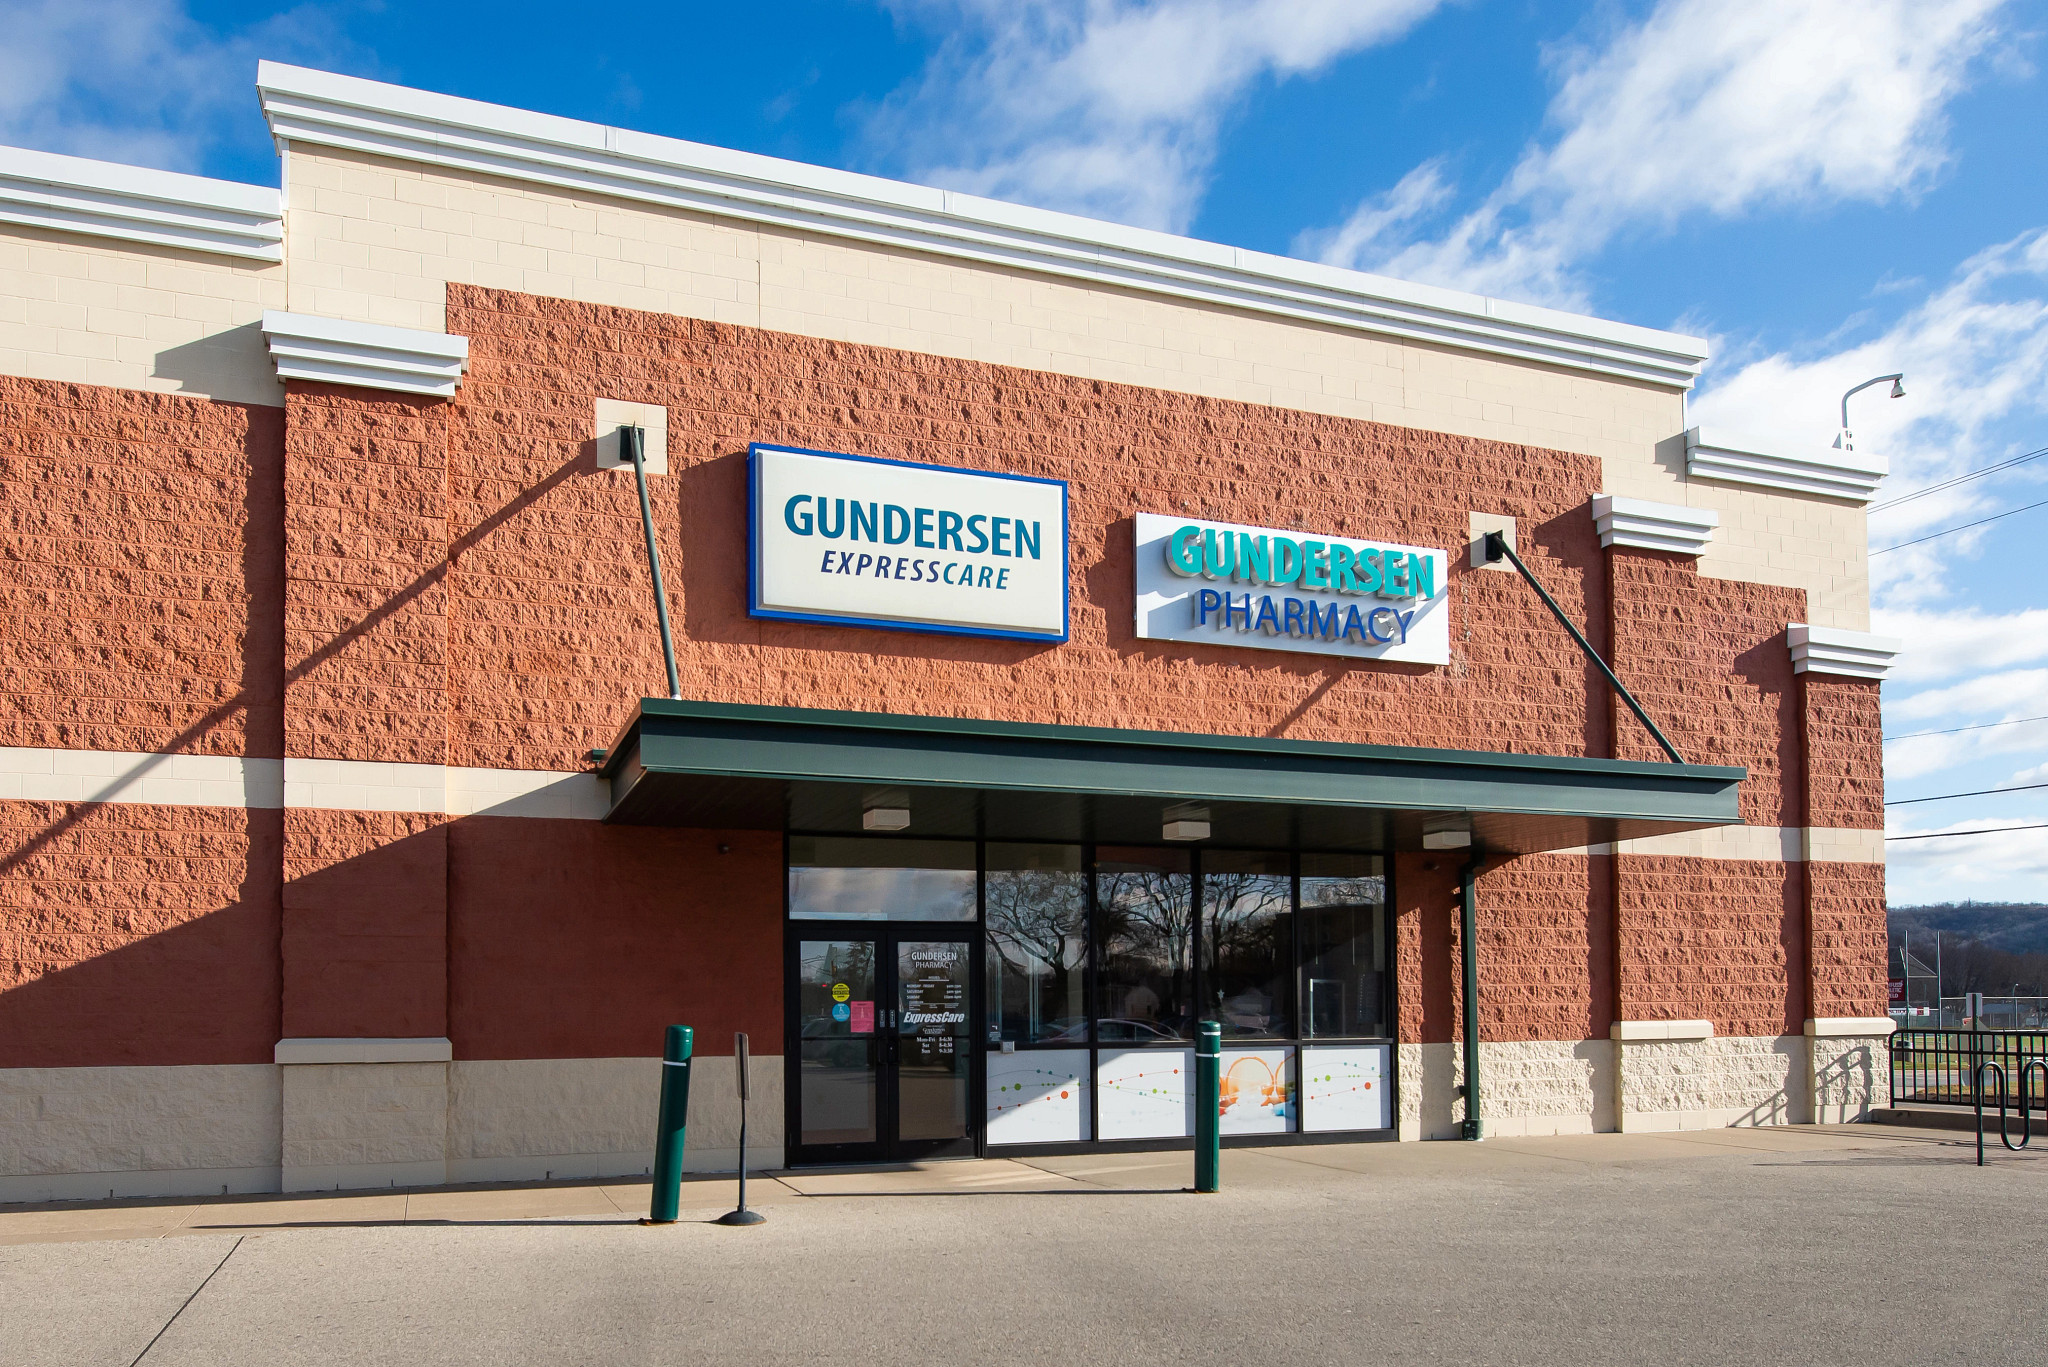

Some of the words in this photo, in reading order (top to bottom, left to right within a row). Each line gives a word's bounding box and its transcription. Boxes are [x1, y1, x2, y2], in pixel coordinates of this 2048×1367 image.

[784, 494, 1041, 560] GUNDERSEN
[820, 550, 1011, 590] EXPRESSCARE
[1168, 525, 1435, 601] GUNDERSEN
[1197, 588, 1415, 644] PHARMACY
[911, 951, 957, 960] GUNDERSEN
[915, 961, 953, 970] PHARMACY
[903, 1012, 965, 1023] ExpressCare
